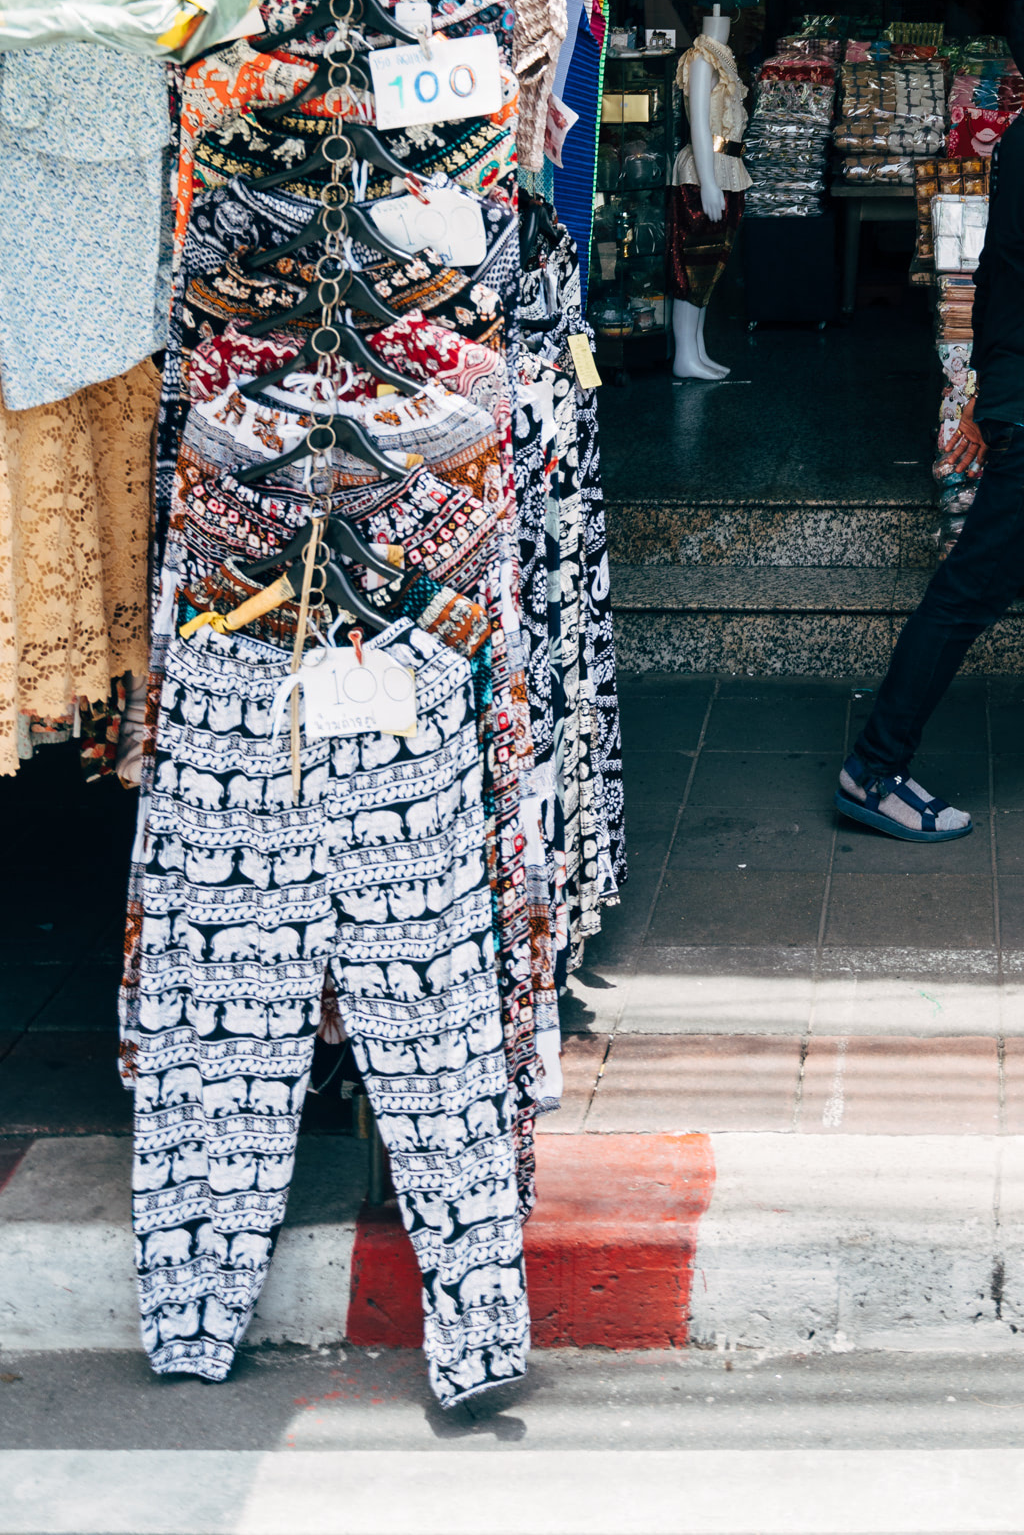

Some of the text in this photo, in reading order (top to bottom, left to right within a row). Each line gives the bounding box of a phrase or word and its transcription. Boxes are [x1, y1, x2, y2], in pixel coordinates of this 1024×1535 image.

[388, 64, 477, 109] 100
[399, 205, 479, 246] 100
[330, 666, 413, 706] 100
